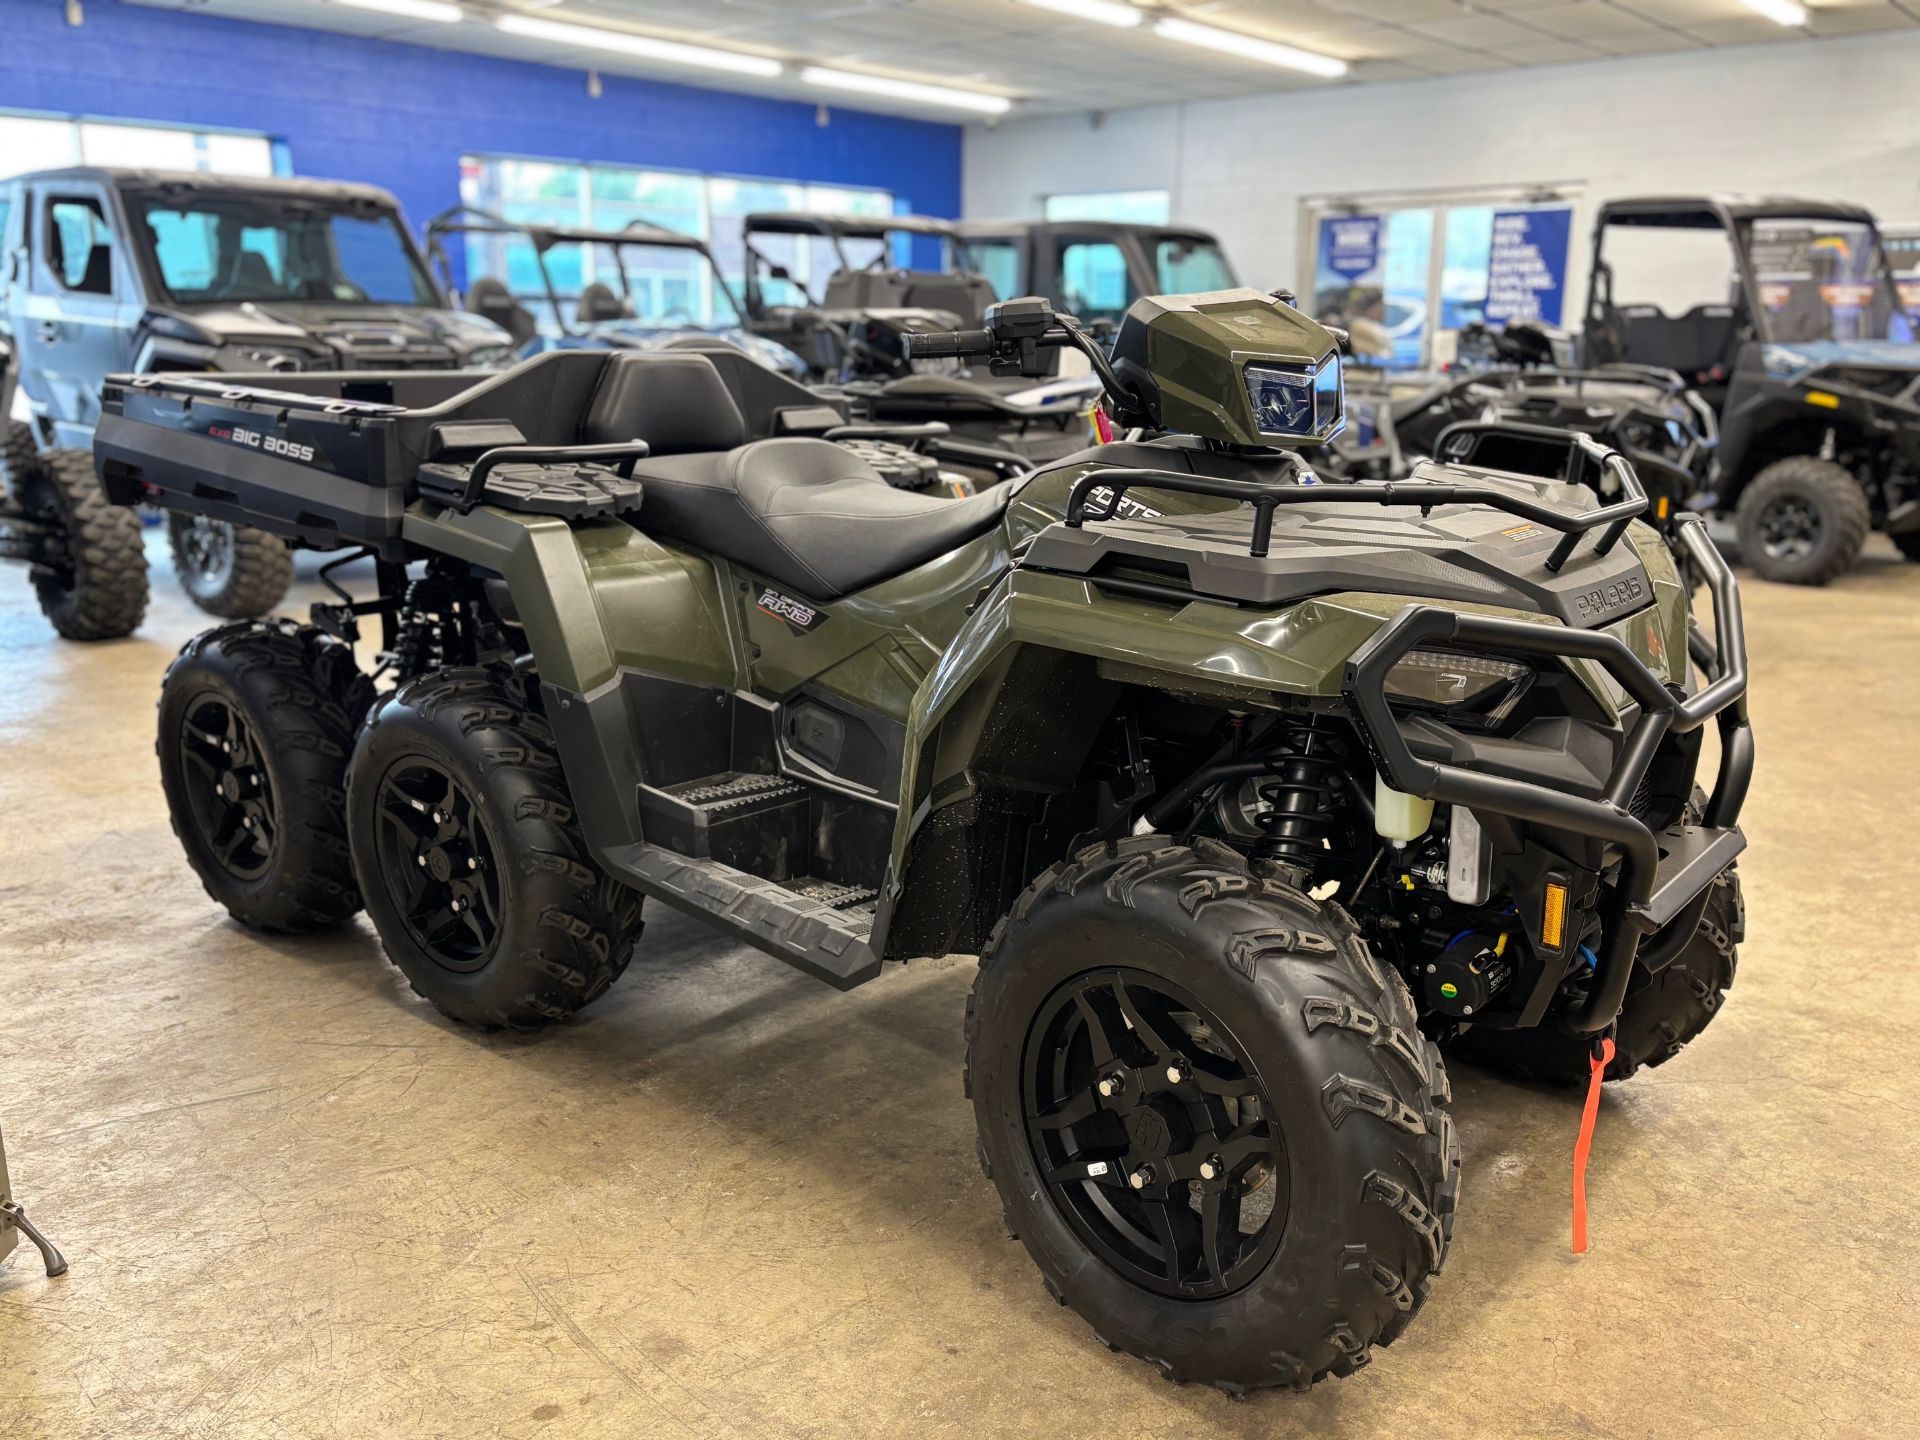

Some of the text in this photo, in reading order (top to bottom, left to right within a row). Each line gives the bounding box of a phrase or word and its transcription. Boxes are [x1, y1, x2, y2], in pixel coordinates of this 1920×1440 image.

[232, 427, 261, 447] BIG
[263, 436, 315, 462] BOSS
[758, 593, 812, 626] AWD
[1574, 576, 1643, 620] POLARIS
